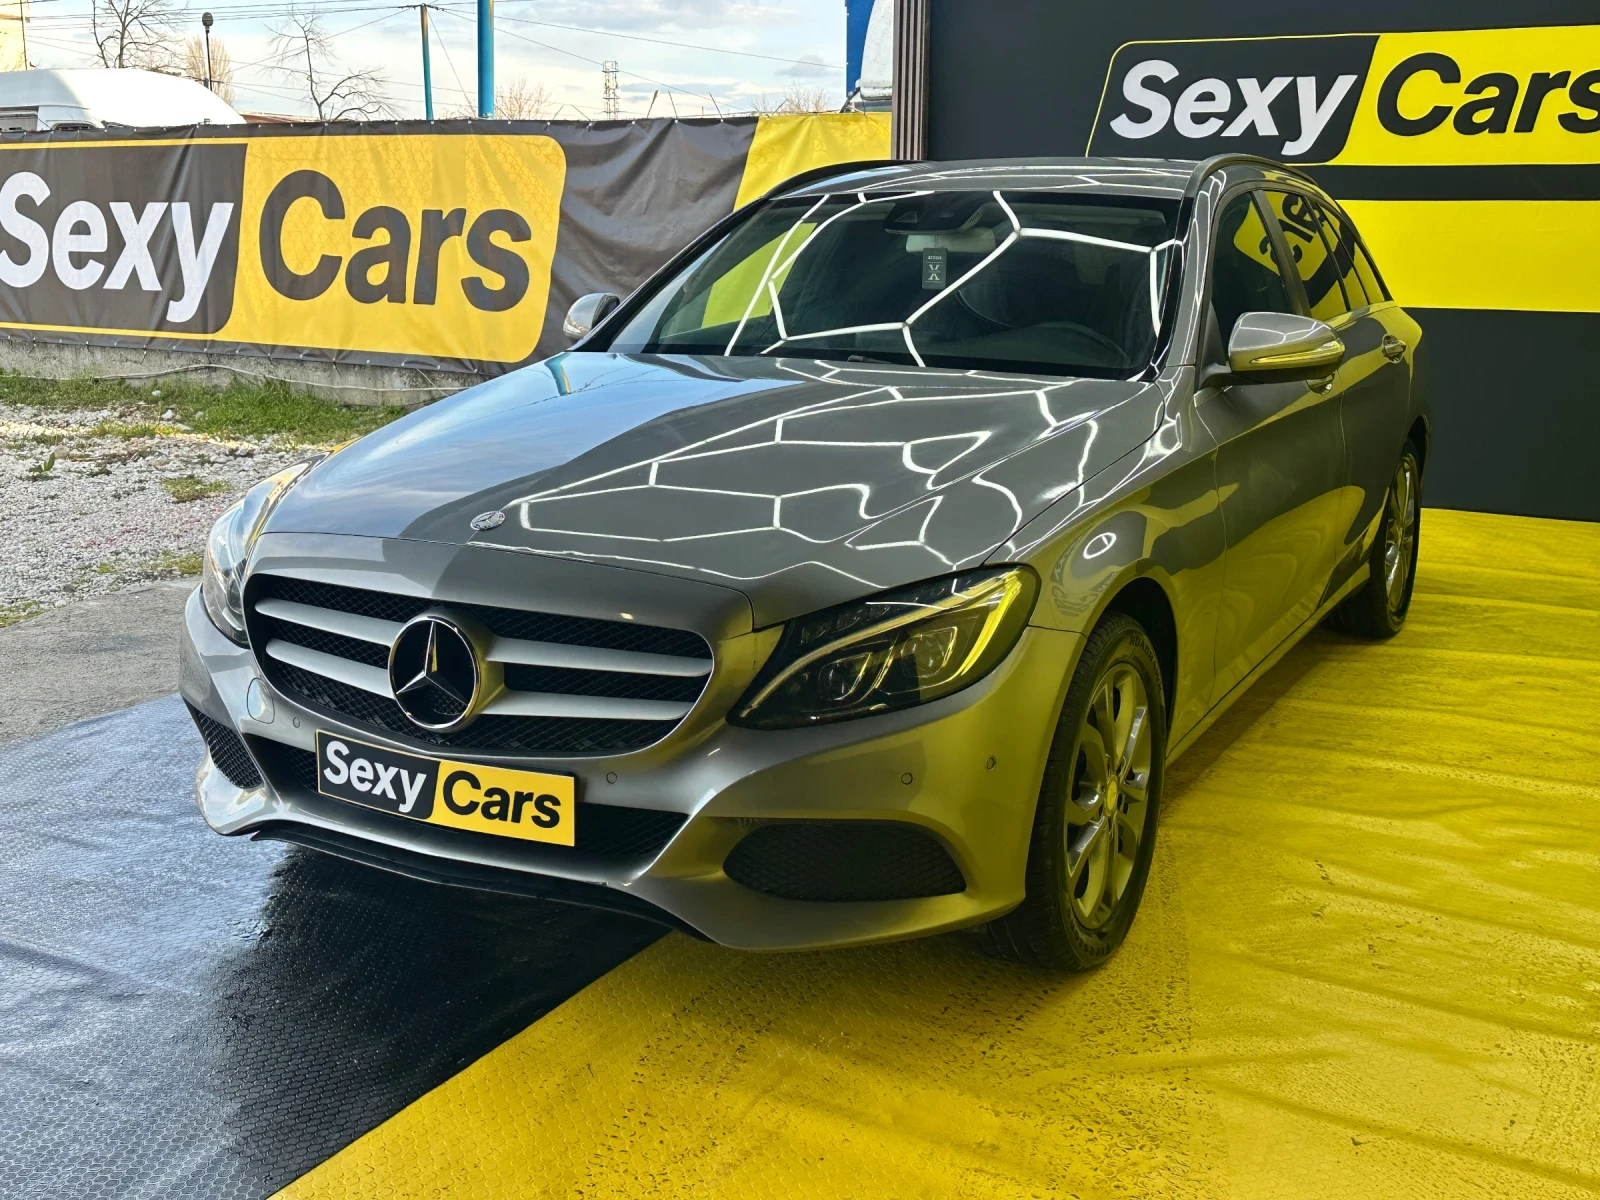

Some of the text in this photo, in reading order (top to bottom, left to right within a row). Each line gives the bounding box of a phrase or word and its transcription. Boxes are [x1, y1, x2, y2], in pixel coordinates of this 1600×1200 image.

[1110, 52, 1600, 156] Sexy Cars
[0, 169, 531, 323] Sexy Cars
[323, 740, 561, 829] Sexy Cars
